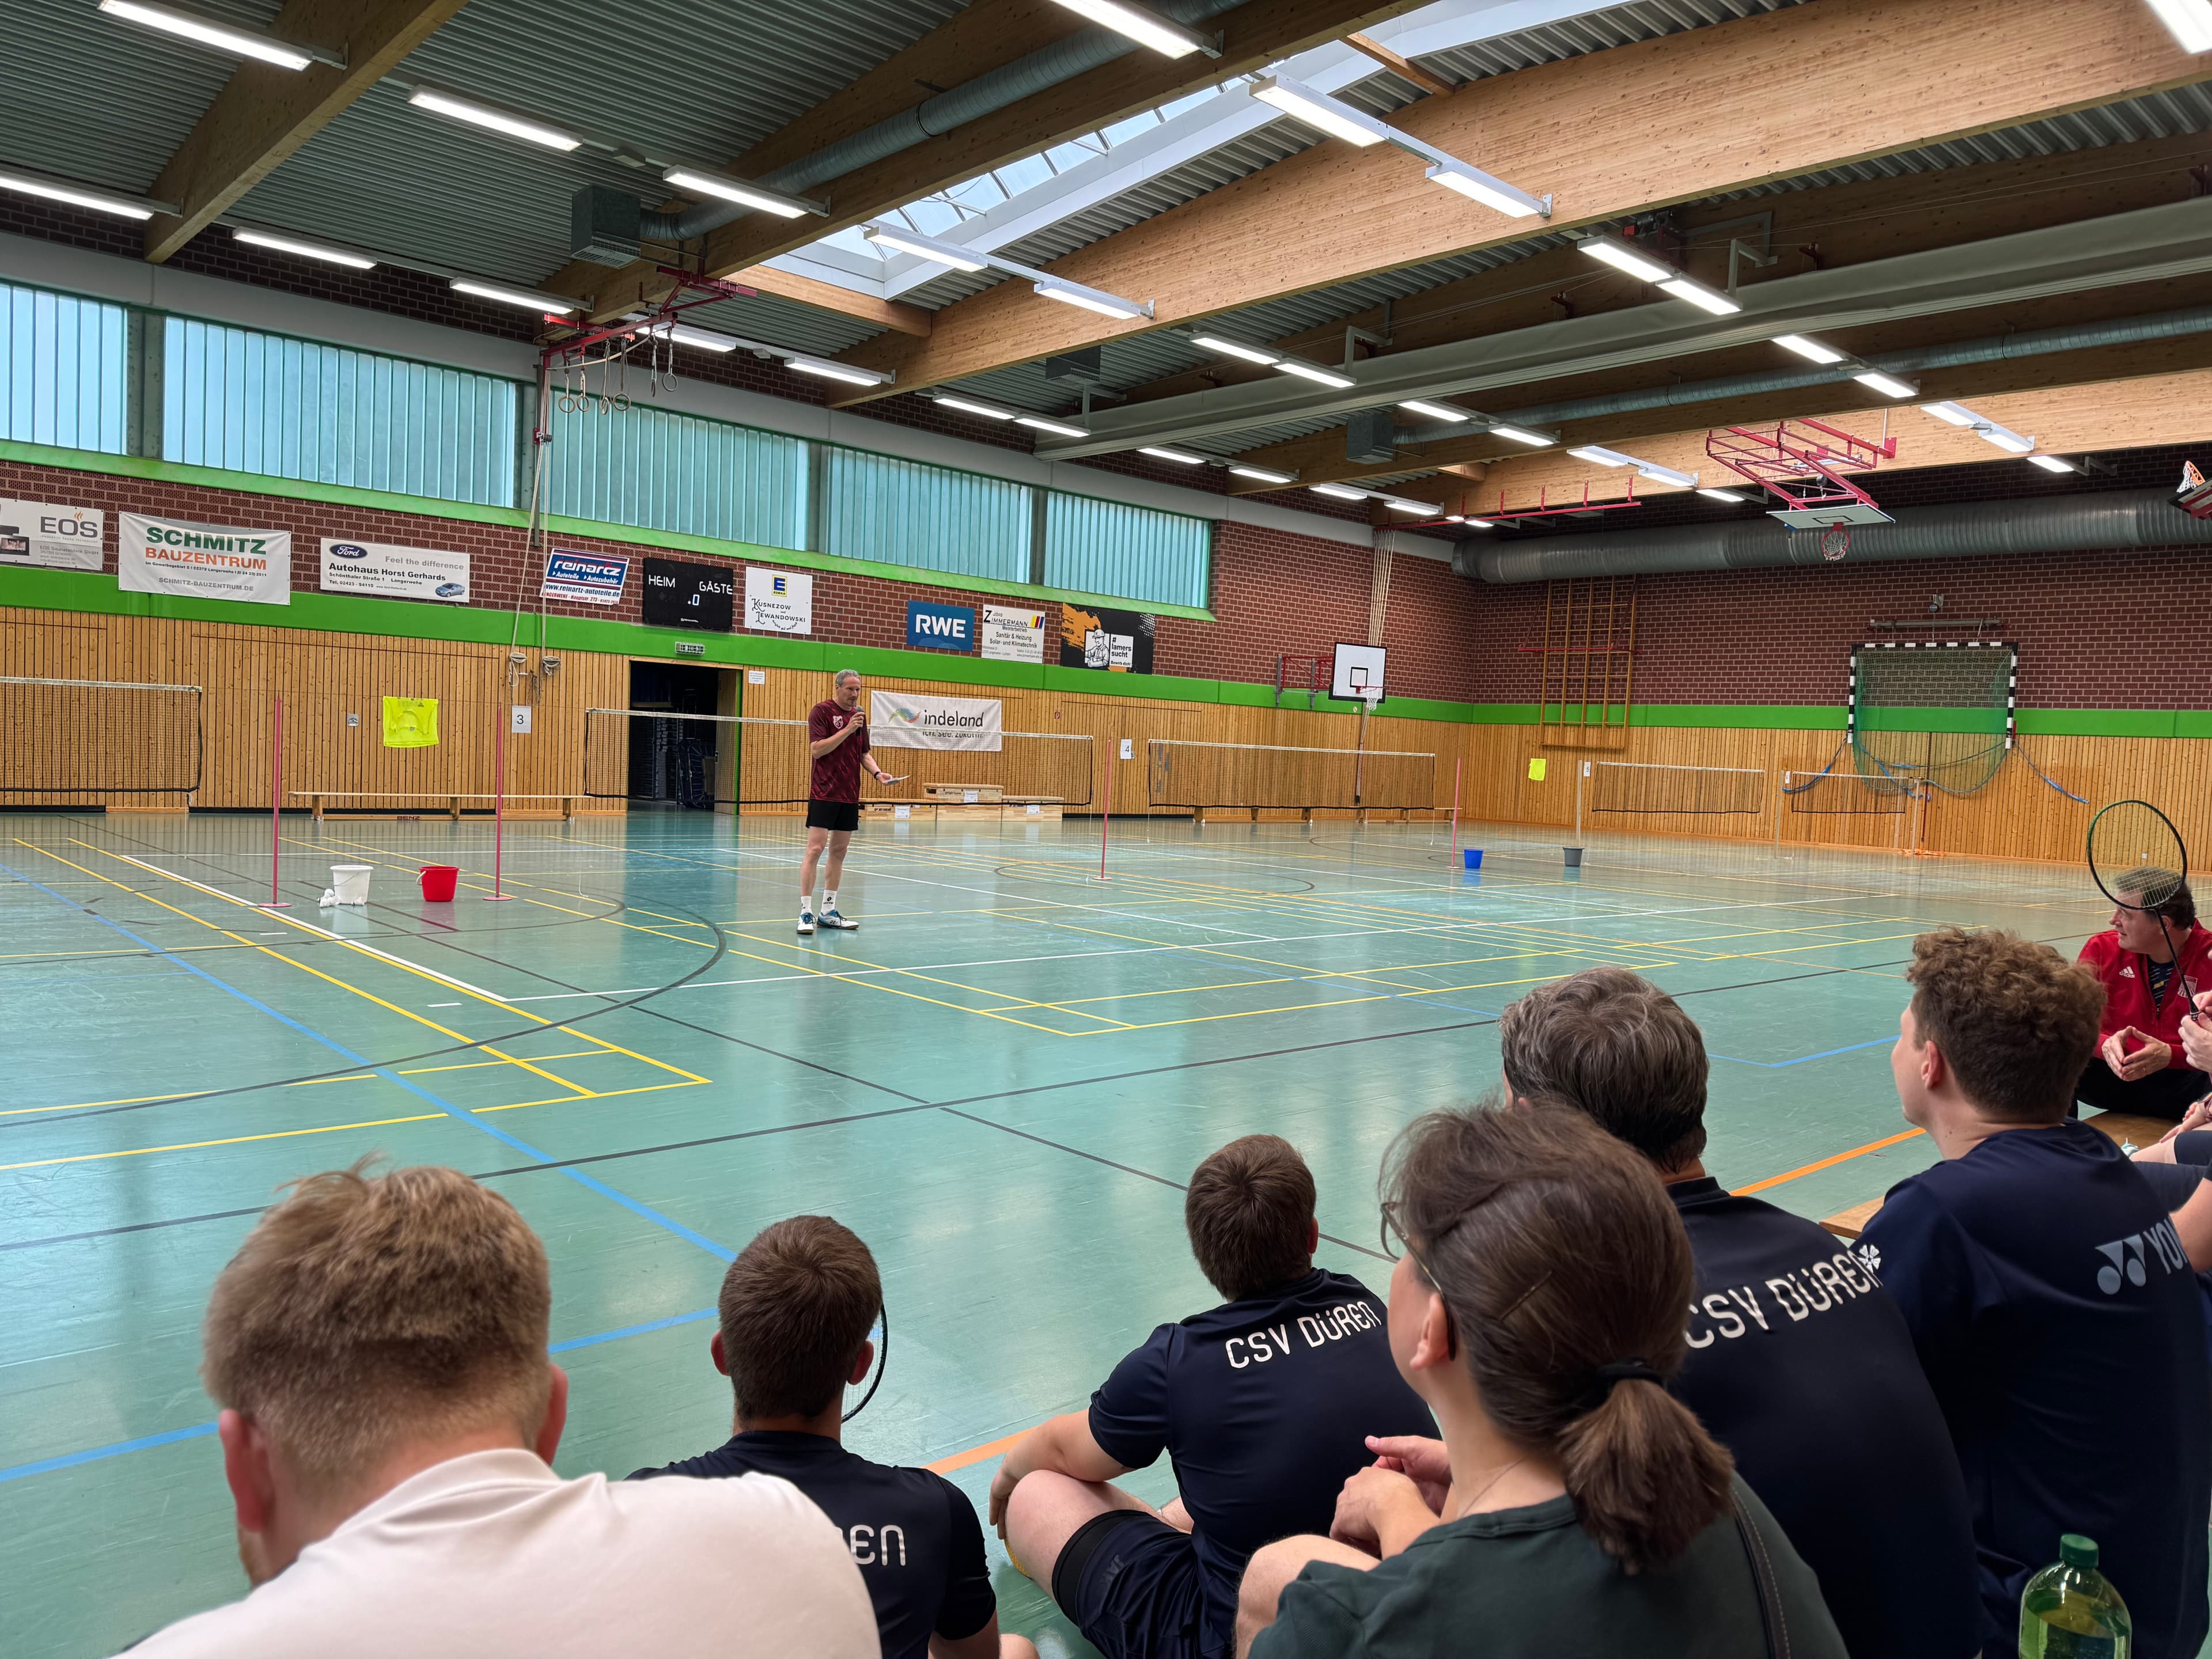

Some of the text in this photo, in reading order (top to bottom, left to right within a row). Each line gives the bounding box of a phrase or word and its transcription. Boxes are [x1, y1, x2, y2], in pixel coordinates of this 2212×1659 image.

[40, 516, 97, 538] EOS
[146, 527, 267, 555] SCHMITZ
[145, 547, 267, 570] BAUZENTRUM
[336, 545, 360, 557] Ford
[329, 562, 446, 581] Autohaus Horst Gerhards
[385, 556, 403, 564] Feel
[422, 560, 464, 570] difference
[554, 559, 622, 576] reinartz
[158, 577, 254, 591] SCHMITZ-BAUZENTRUM.DE
[391, 578, 422, 586] Langerwehe
[556, 571, 619, 584] Autoteile Autozubehör
[648, 574, 733, 595] HEIM GÄSTE
[751, 598, 791, 612] KUSNEZOW
[756, 611, 806, 625] LEWANDOWSKI
[915, 613, 967, 638] RWE
[983, 609, 1029, 627] ZIMMERMANN
[1111, 643, 1132, 652] lamers
[517, 714, 524, 725] 3
[924, 709, 984, 728] indeland
[1225, 1301, 1382, 1369] CSV DÜREN
[835, 1524, 906, 1566] EN
